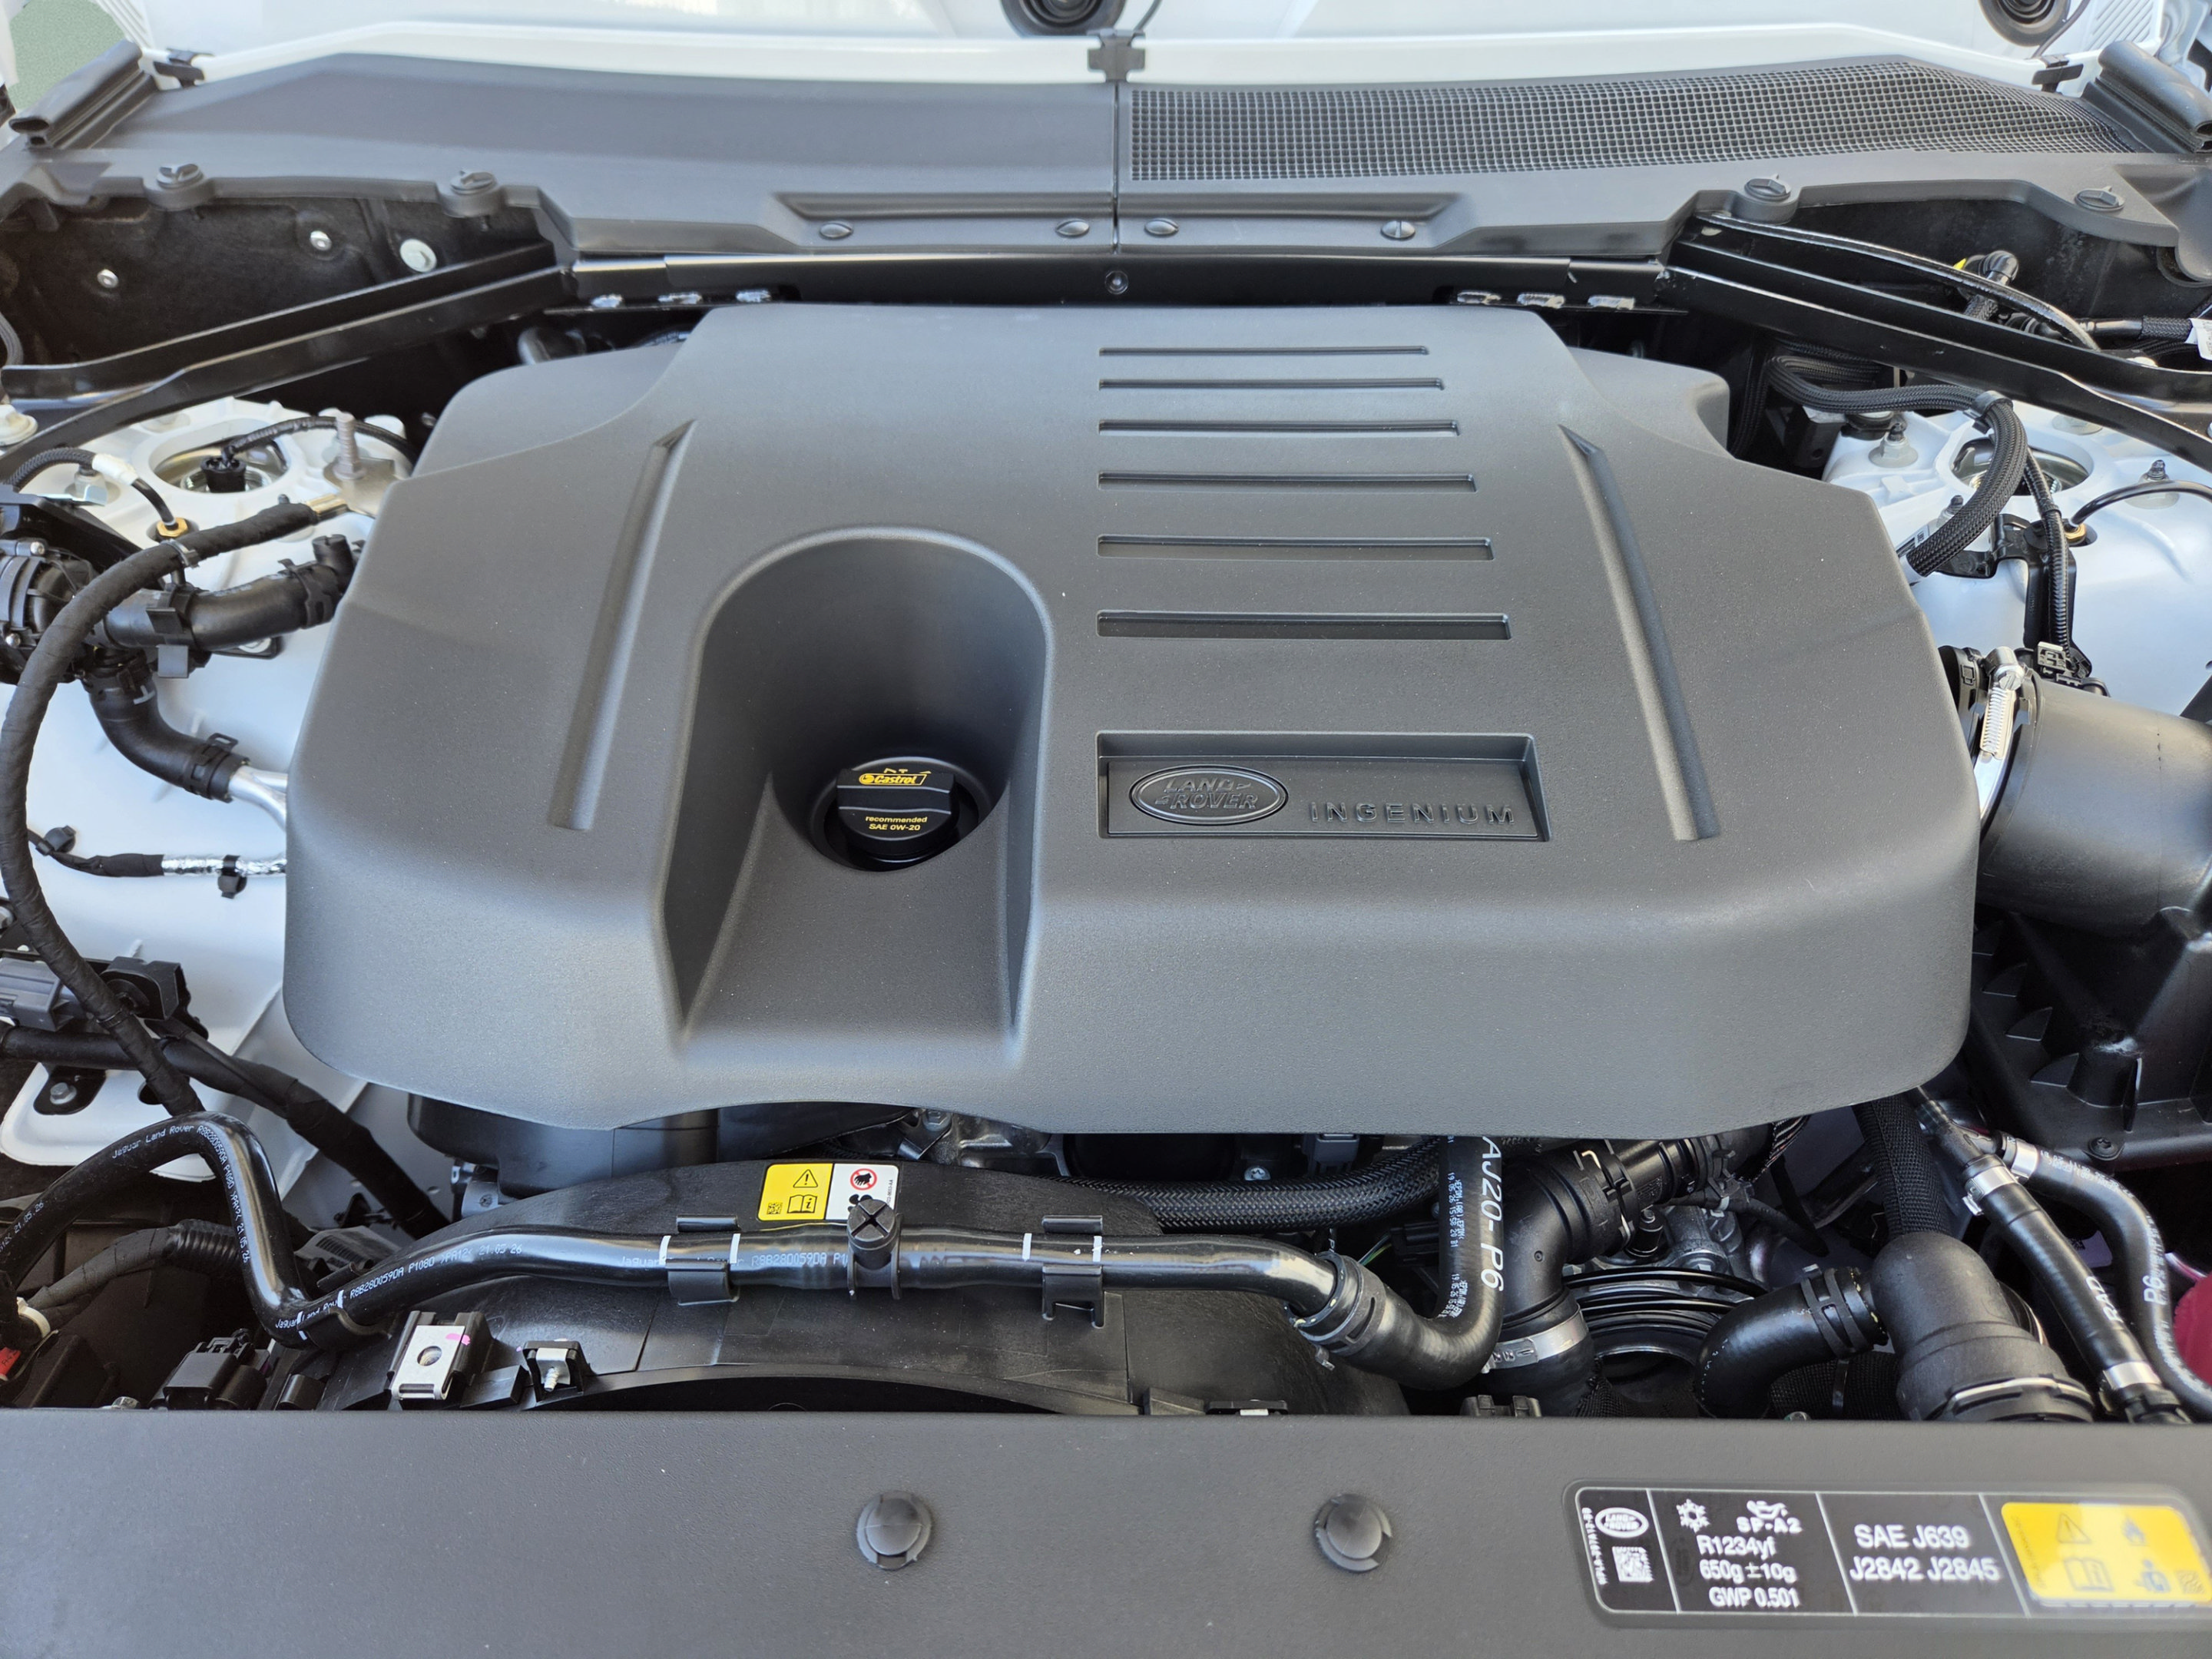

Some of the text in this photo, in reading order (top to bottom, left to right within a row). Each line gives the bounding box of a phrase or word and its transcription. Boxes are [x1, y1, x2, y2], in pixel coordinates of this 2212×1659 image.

[874, 775, 917, 784] Castrol
[1162, 777, 1234, 793] LAND
[1169, 793, 1258, 810] ROVER
[1310, 801, 1515, 825] INGENIUM
[111, 1139, 142, 1159] Jaguar
[145, 1128, 166, 1144] Land
[169, 1124, 195, 1135] Rover
[2085, 1276, 2125, 1323] RAD
[1736, 1516, 1803, 1534] SP-A2
[1853, 1523, 1972, 1549] SAE J639
[1697, 1535, 1777, 1561] R1234yf
[1699, 1559, 1798, 1584] 650g ±10g
[1849, 1555, 2002, 1581] J2842 J2845
[1708, 1586, 1801, 1608] GWP 0.501
